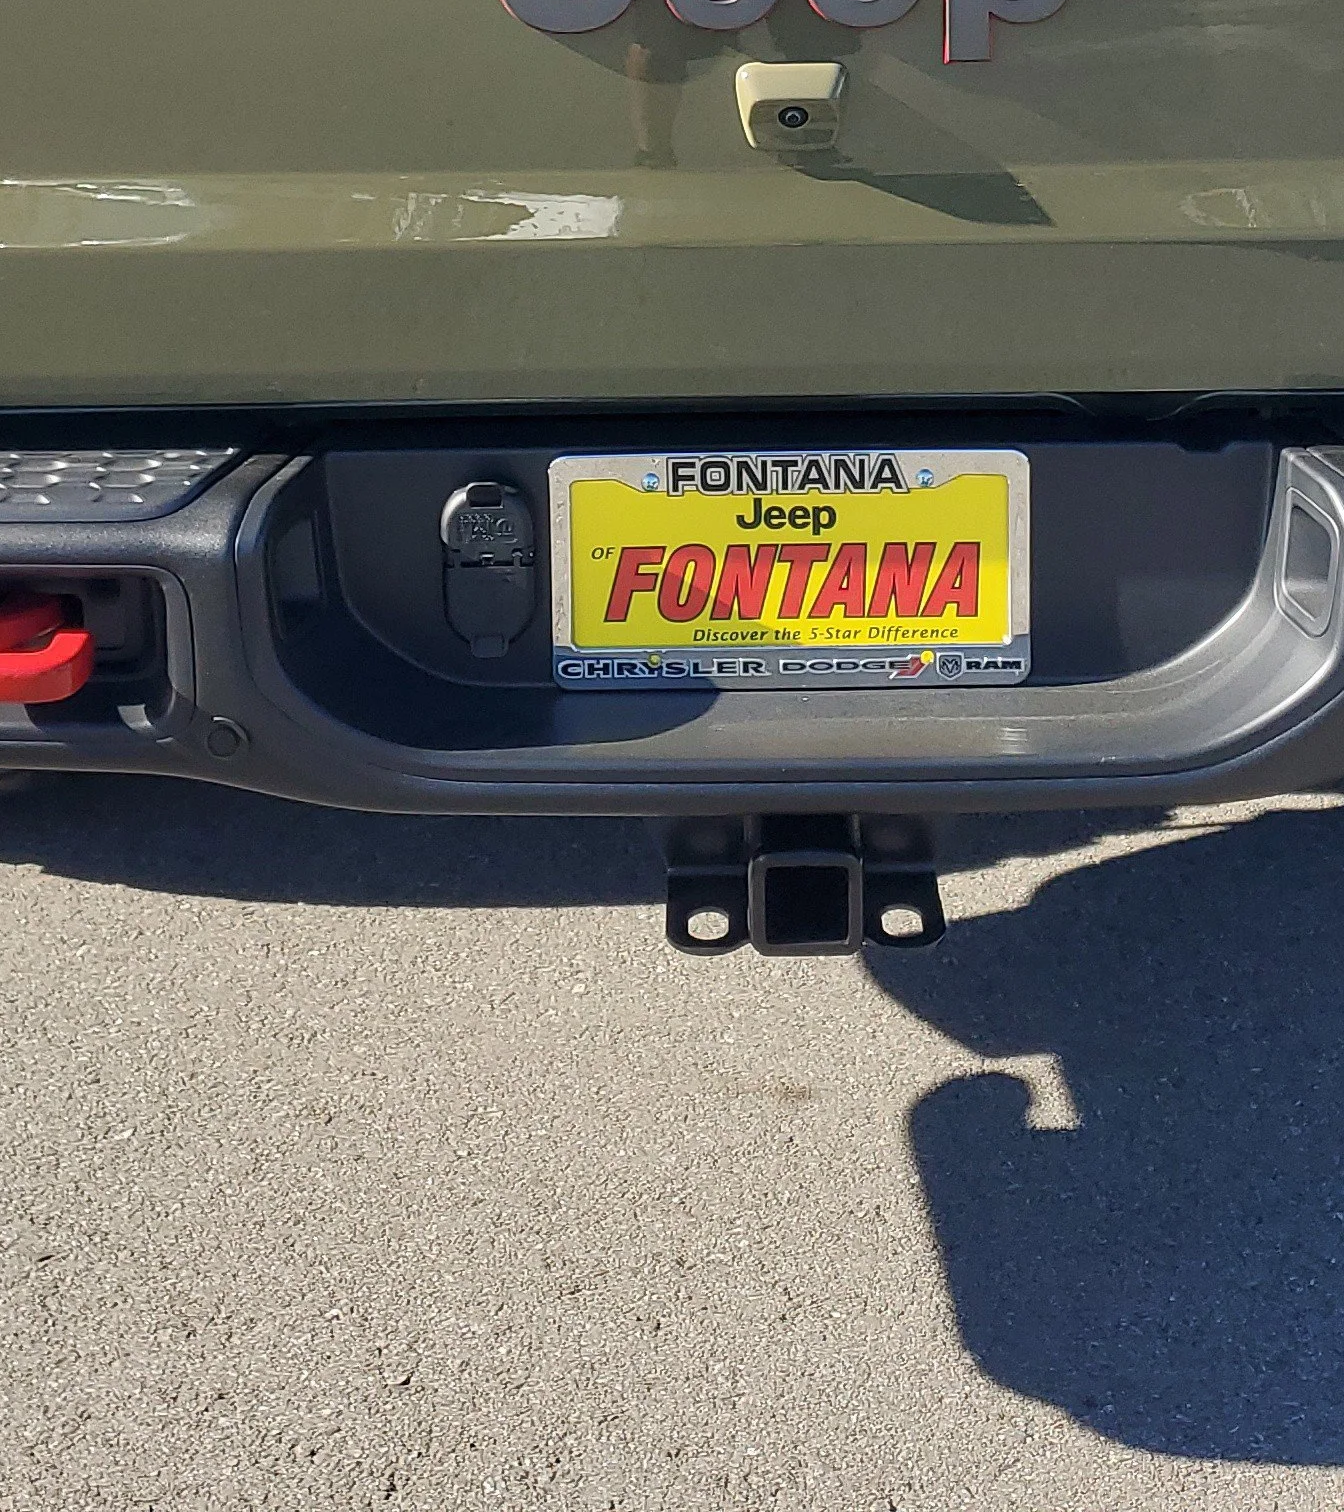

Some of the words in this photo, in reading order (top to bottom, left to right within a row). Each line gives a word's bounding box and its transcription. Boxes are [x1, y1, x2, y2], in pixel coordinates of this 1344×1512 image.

[666, 454, 911, 497] FONTANA
[736, 498, 837, 536] Jeep
[591, 547, 616, 560] OF
[603, 541, 981, 623] FONTANA
[692, 628, 769, 642] Discover
[773, 628, 801, 641] the
[808, 627, 862, 640] 5-Star
[868, 626, 959, 641] Difference
[558, 657, 772, 679] CHRYSLER
[779, 656, 913, 674] DODGE
[964, 658, 1022, 672] RAM
